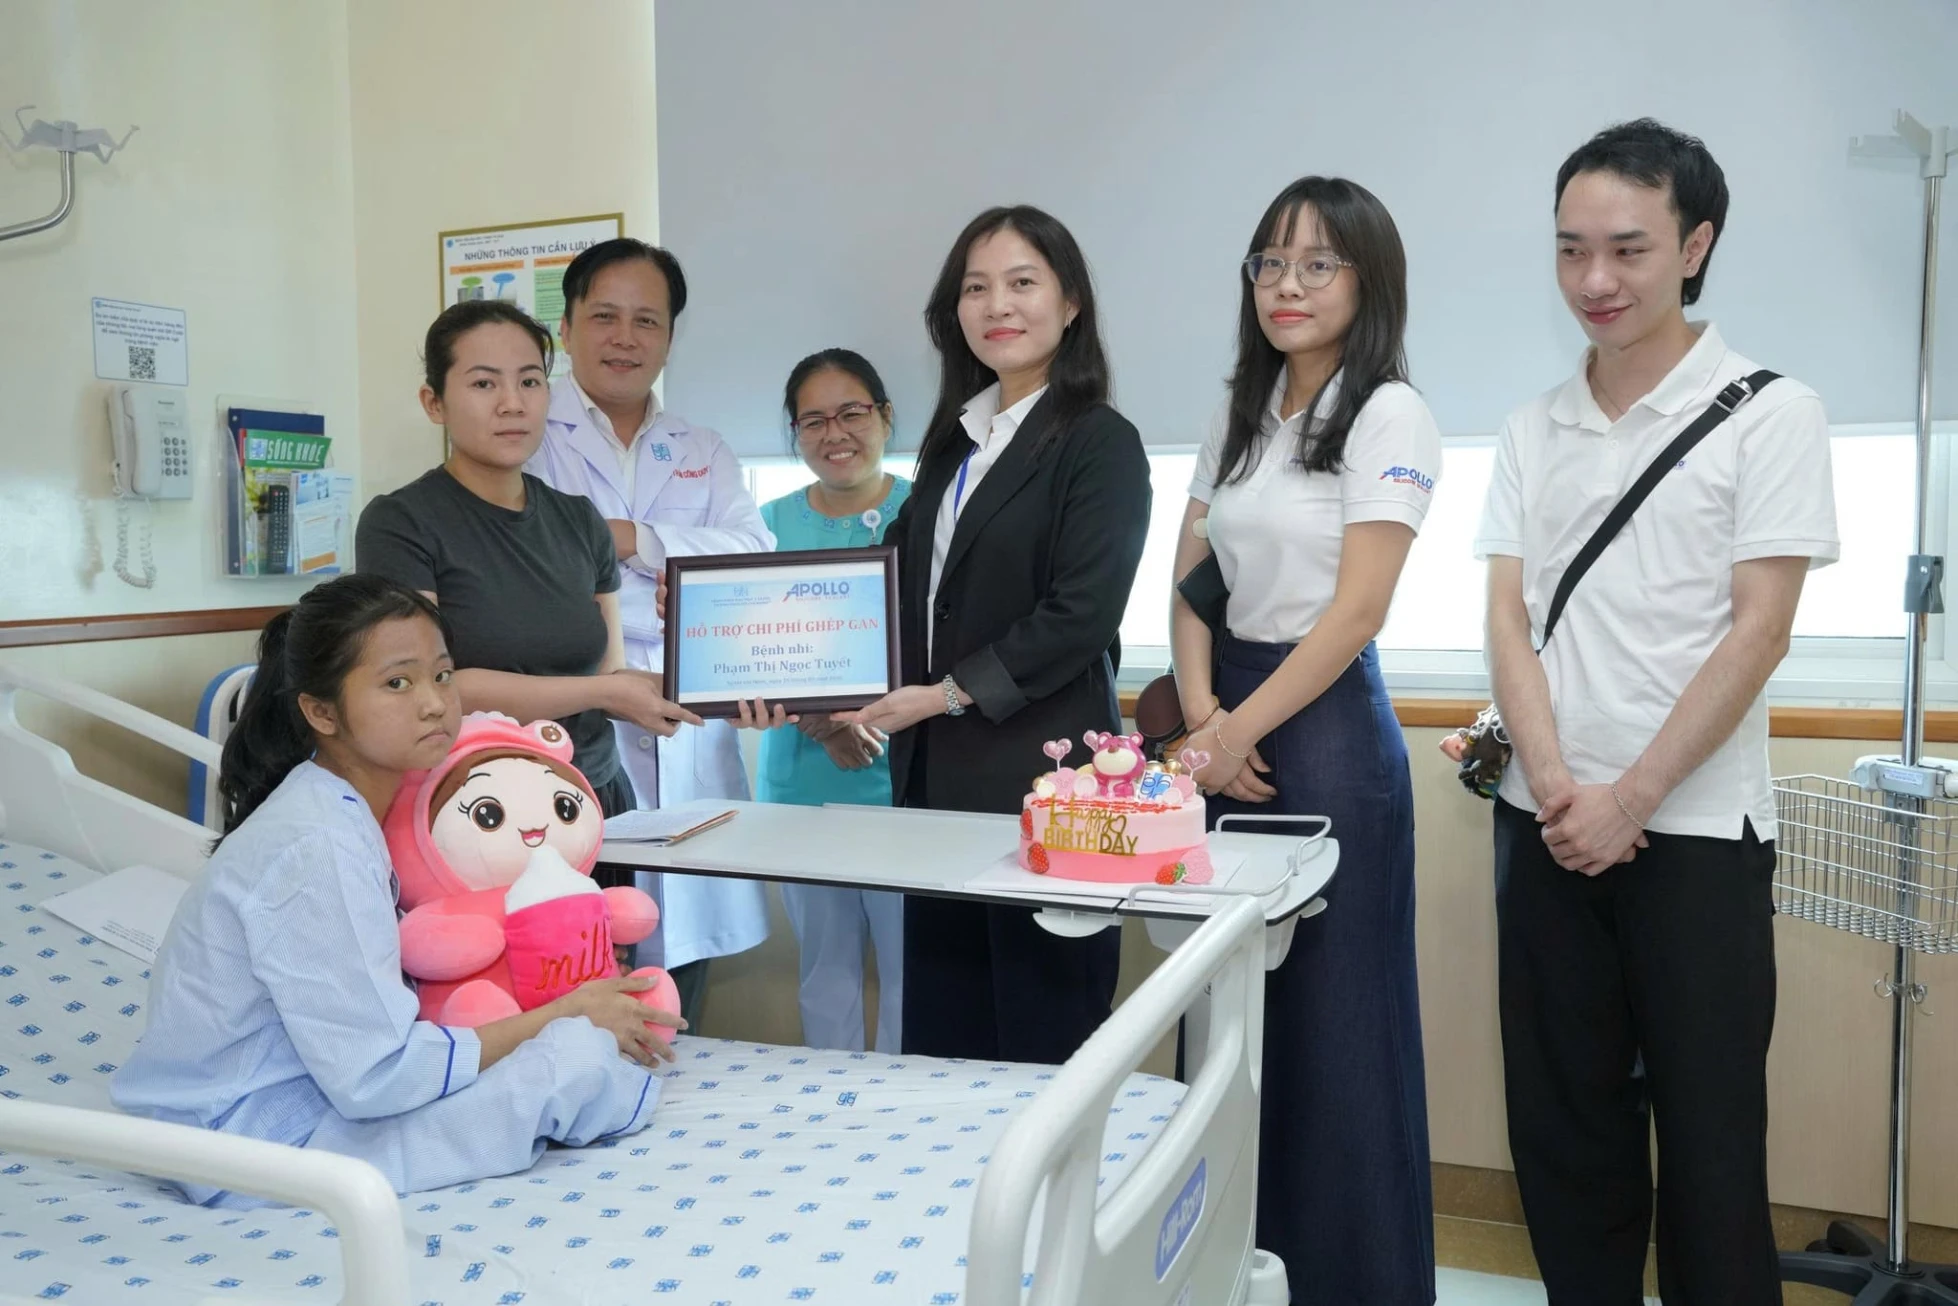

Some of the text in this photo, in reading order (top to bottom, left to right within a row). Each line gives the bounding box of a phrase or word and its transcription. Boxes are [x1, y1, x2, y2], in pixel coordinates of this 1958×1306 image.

[498, 244, 529, 257] THÔNG
[532, 244, 546, 255] TIN
[1379, 466, 1433, 489] APOLLO
[783, 581, 850, 602] APOLLO
[711, 624, 744, 638] TRỢ
[747, 622, 771, 636] CHI
[805, 617, 844, 632] GHÉP
[848, 618, 878, 630] GAN
[751, 643, 814, 658] Bệnh nhi:
[713, 661, 750, 676] Phạm
[754, 660, 776, 674] Thị
[779, 659, 811, 674] Ngọc
[1049, 792, 1115, 833] Happy
[1043, 828, 1139, 857] BIRTHDAY
[535, 917, 612, 990] milk
